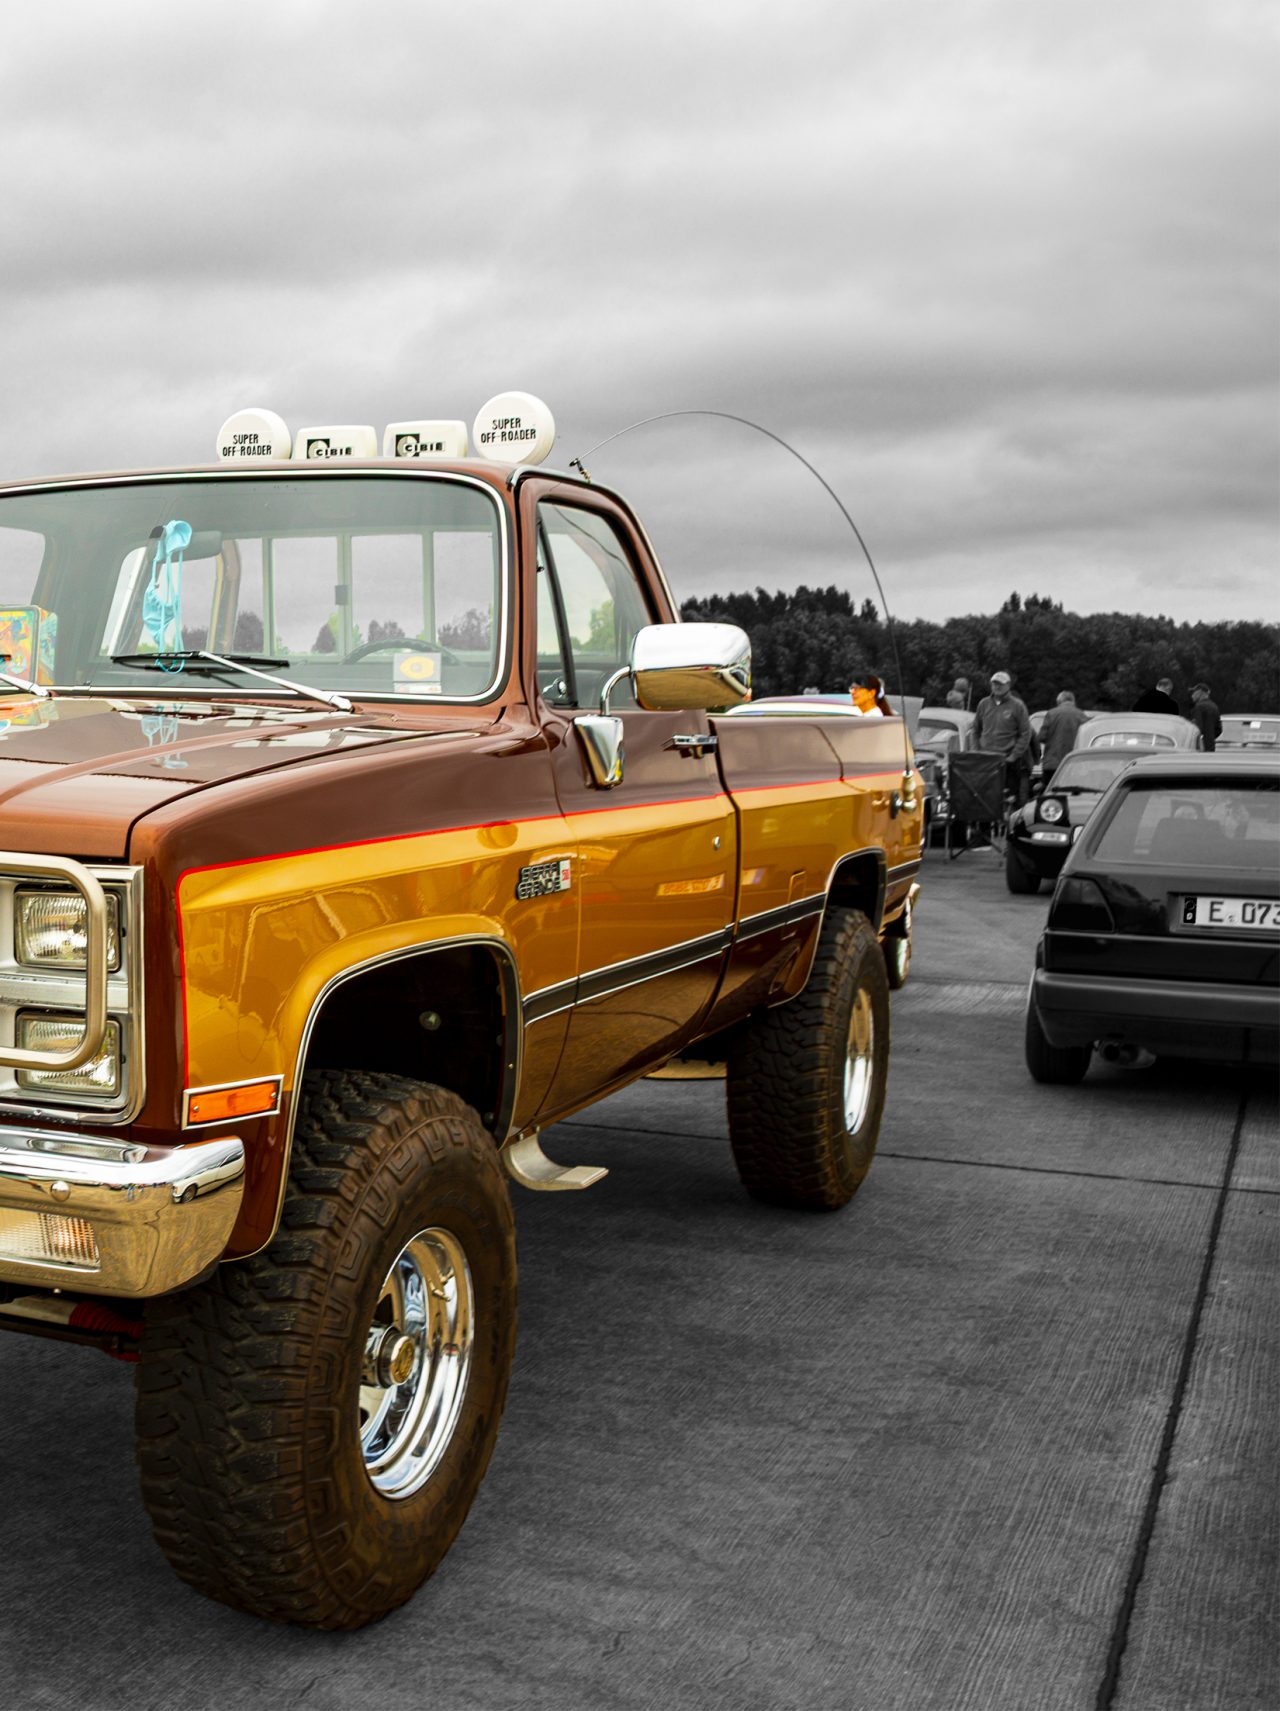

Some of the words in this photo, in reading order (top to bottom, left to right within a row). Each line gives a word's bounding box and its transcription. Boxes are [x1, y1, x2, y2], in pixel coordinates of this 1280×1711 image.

[492, 417, 522, 430] SUPER
[233, 433, 259, 445] SUPER
[480, 428, 537, 443] OFF-ROADER
[222, 445, 272, 457] OFF-ROADER
[521, 861, 558, 882] SIERRA
[517, 876, 561, 900] GRANDE
[1209, 901, 1224, 922] E
